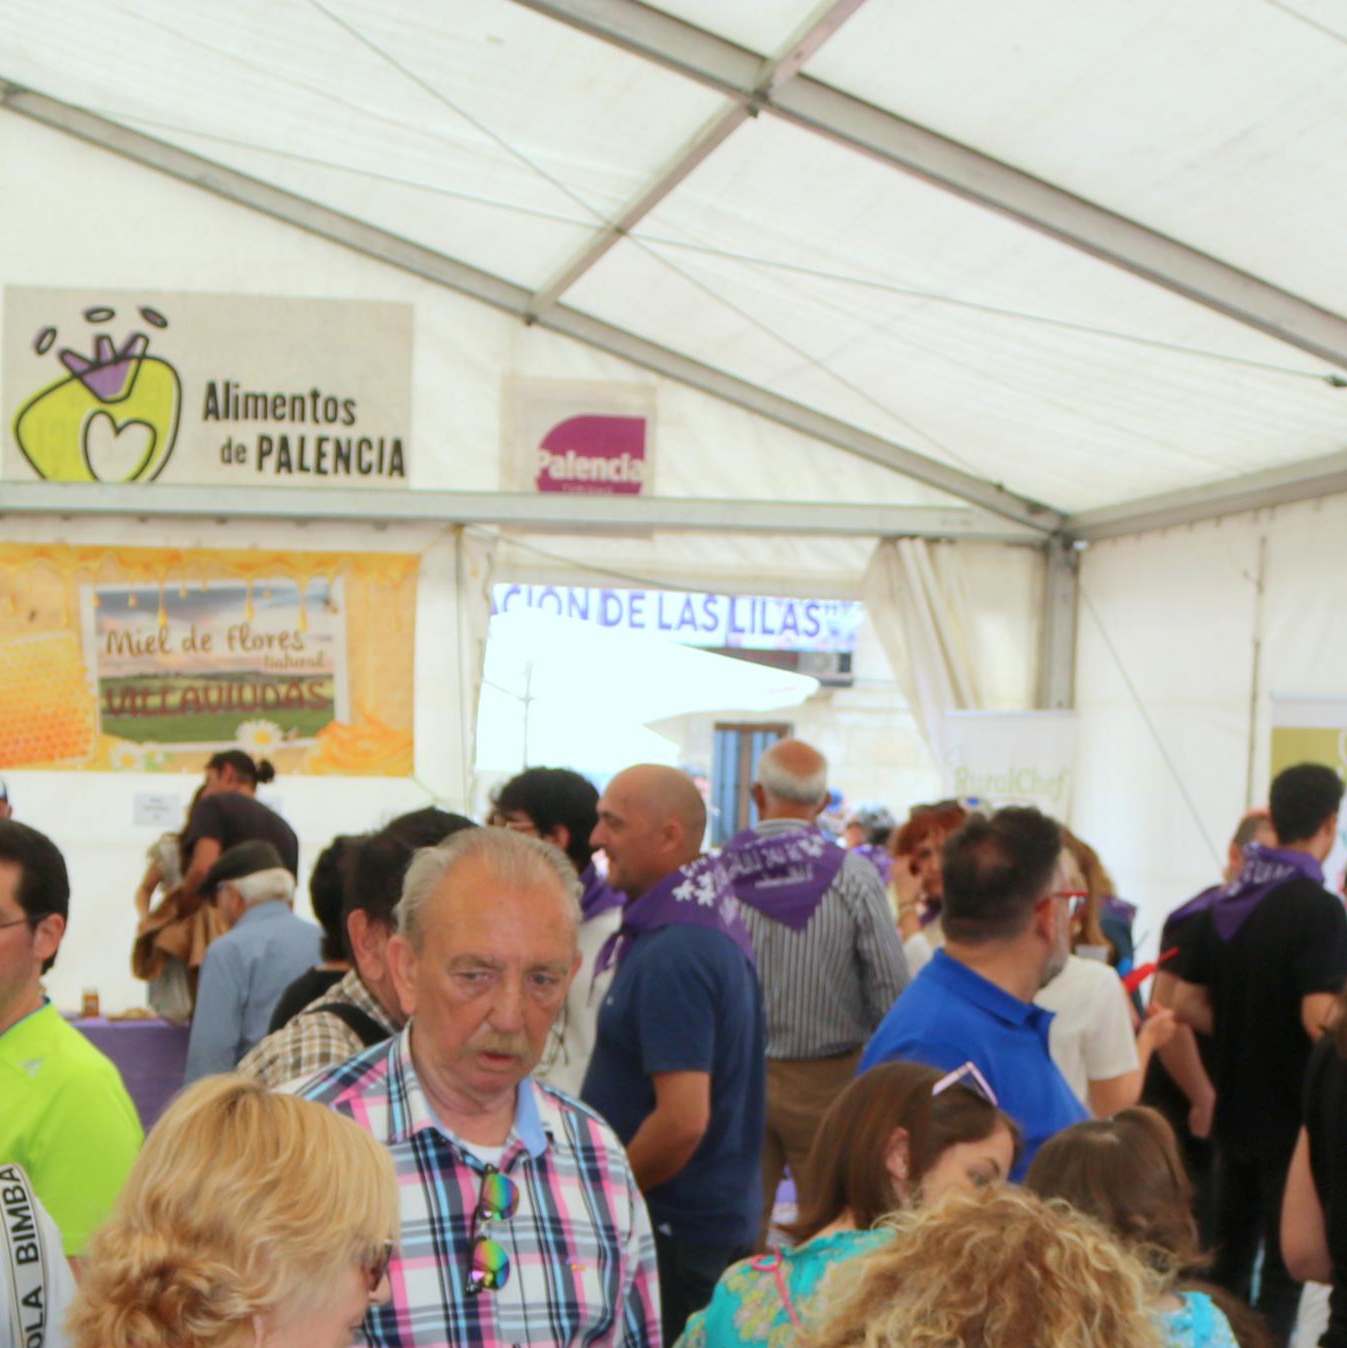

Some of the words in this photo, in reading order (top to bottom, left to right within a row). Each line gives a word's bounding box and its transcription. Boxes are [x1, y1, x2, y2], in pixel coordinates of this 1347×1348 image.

[203, 379, 357, 426] Alimentos
[220, 437, 247, 465] de
[256, 434, 406, 478] PALENCIA
[536, 450, 645, 484] Palencia
[602, 591, 645, 630] DE
[657, 593, 719, 633] LAS
[105, 627, 172, 657] Miel
[181, 624, 212, 652] de
[105, 681, 330, 718] VILLAVIUDAS
